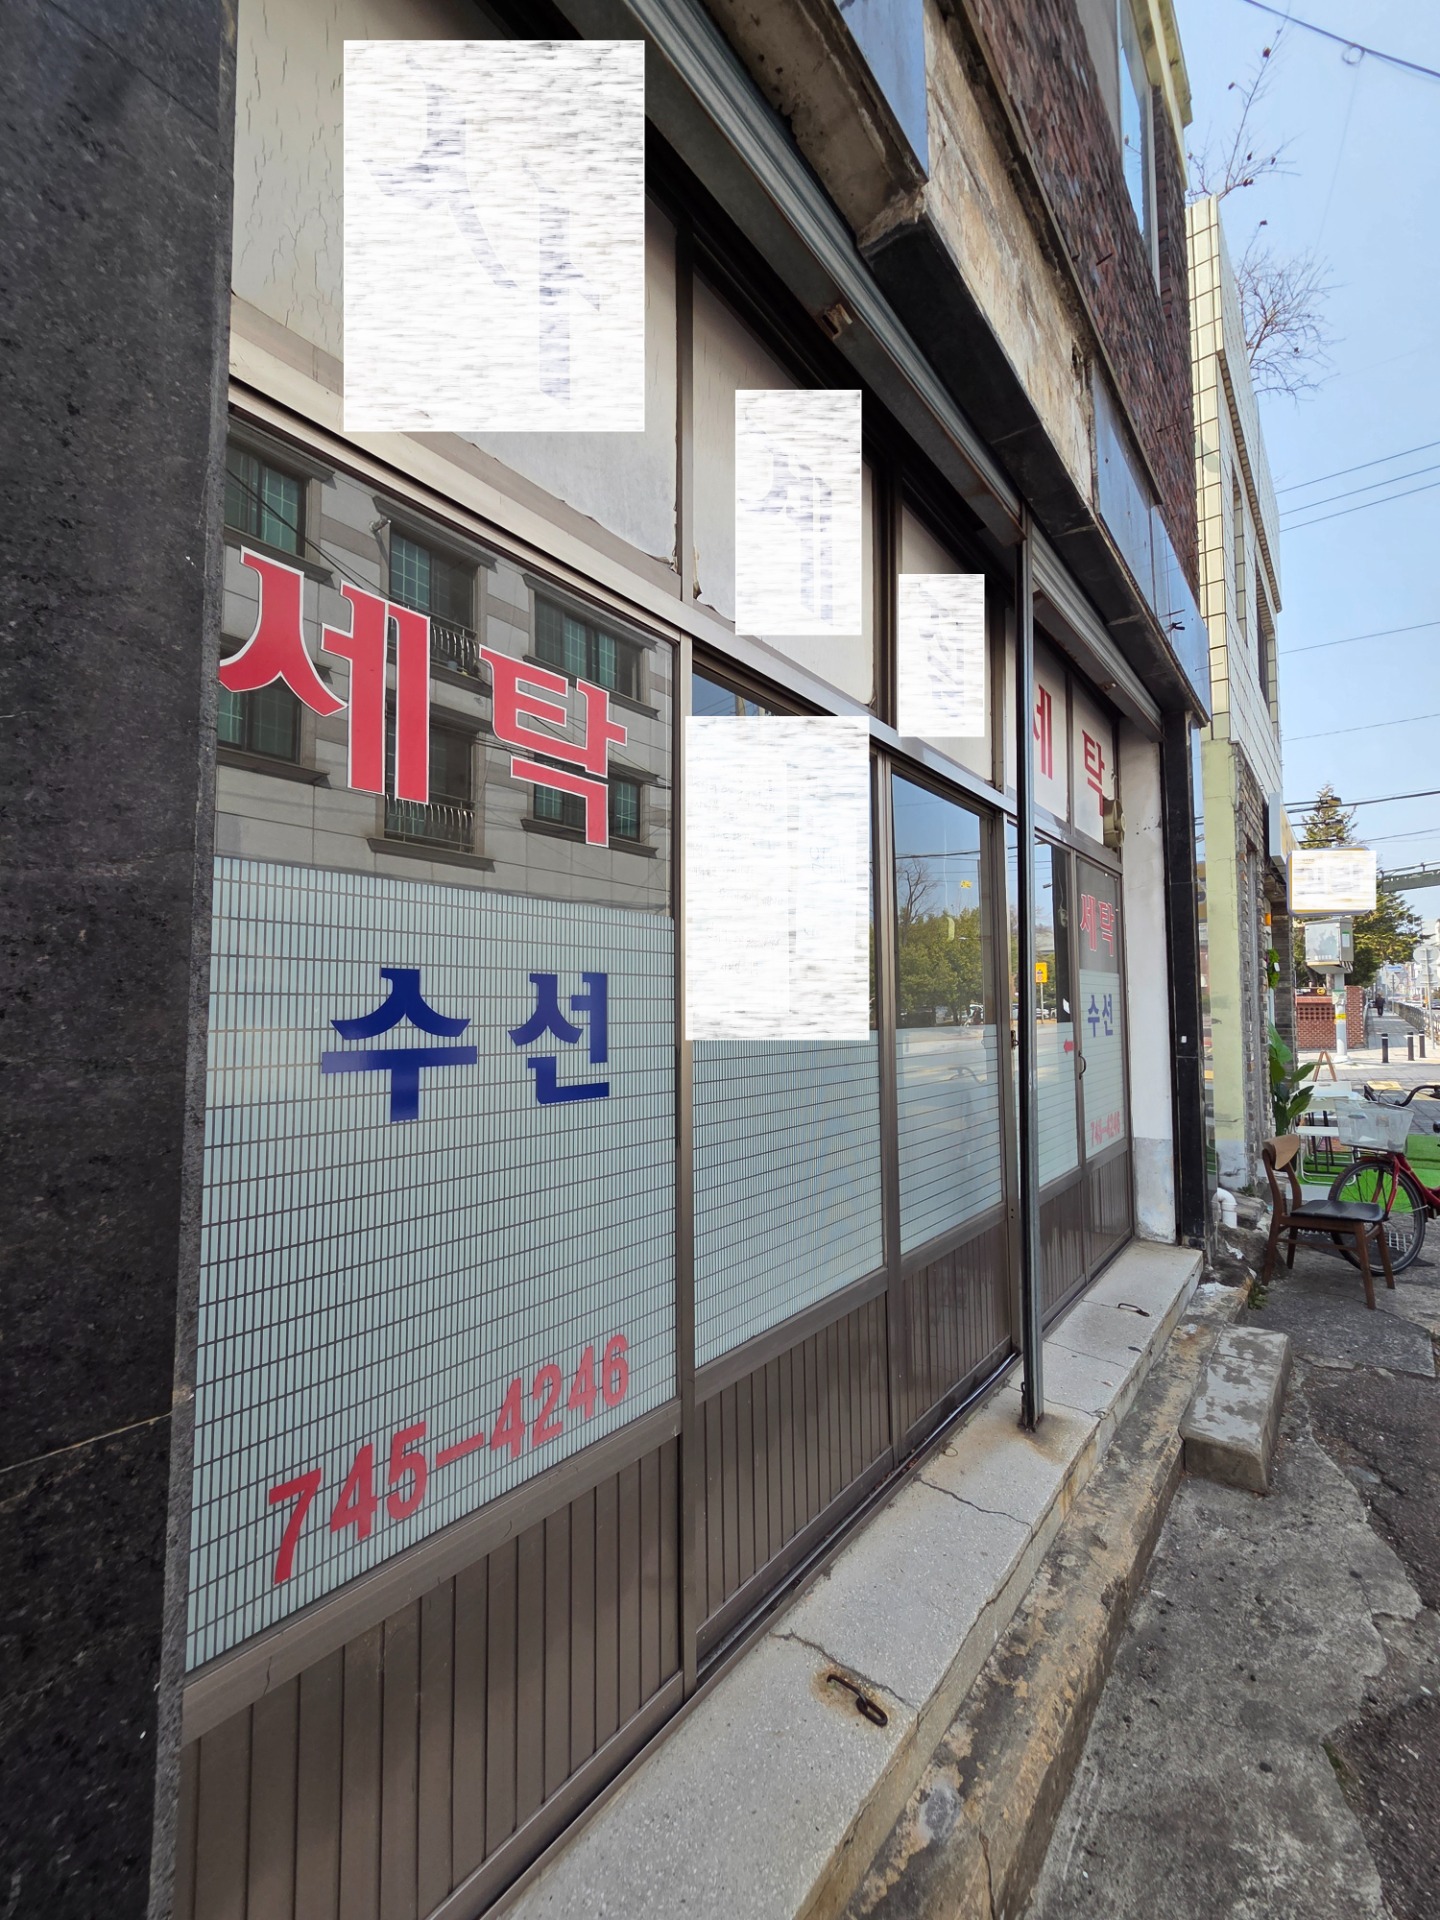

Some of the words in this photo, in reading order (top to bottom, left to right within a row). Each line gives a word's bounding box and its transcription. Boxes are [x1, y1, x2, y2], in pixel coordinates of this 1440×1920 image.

[219, 545, 628, 848] 세탁
[1080, 893, 1114, 957] 세탁
[322, 968, 610, 1123] 수선
[1088, 993, 1113, 1038] 수선
[269, 1334, 629, 1585] 745-4246
